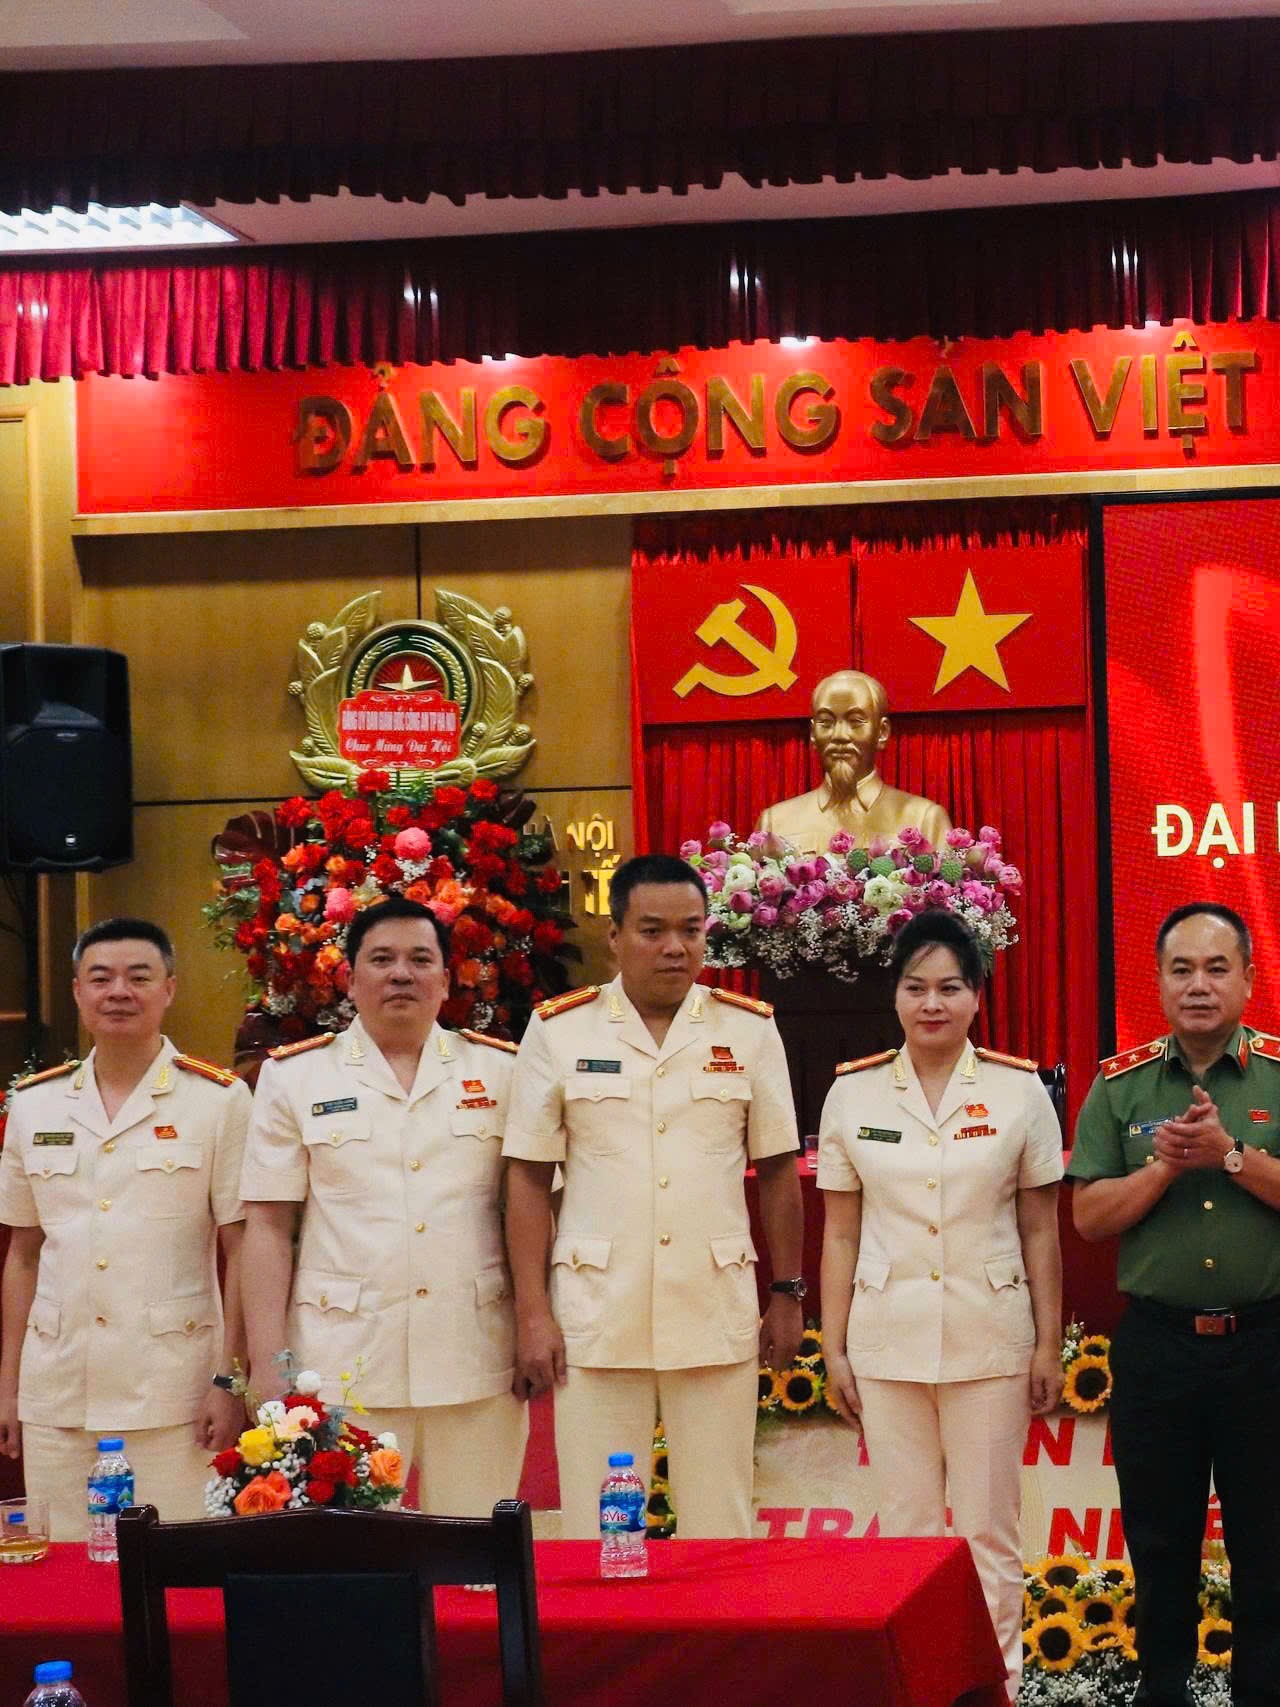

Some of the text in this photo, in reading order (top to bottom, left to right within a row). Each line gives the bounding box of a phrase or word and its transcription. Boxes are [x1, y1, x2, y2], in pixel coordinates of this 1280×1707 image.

[294, 361, 549, 474] ĐẢNG
[579, 358, 841, 478] CỘNG
[1070, 331, 1258, 457] VIỆT
[1151, 802, 1255, 868] ĐẠI
